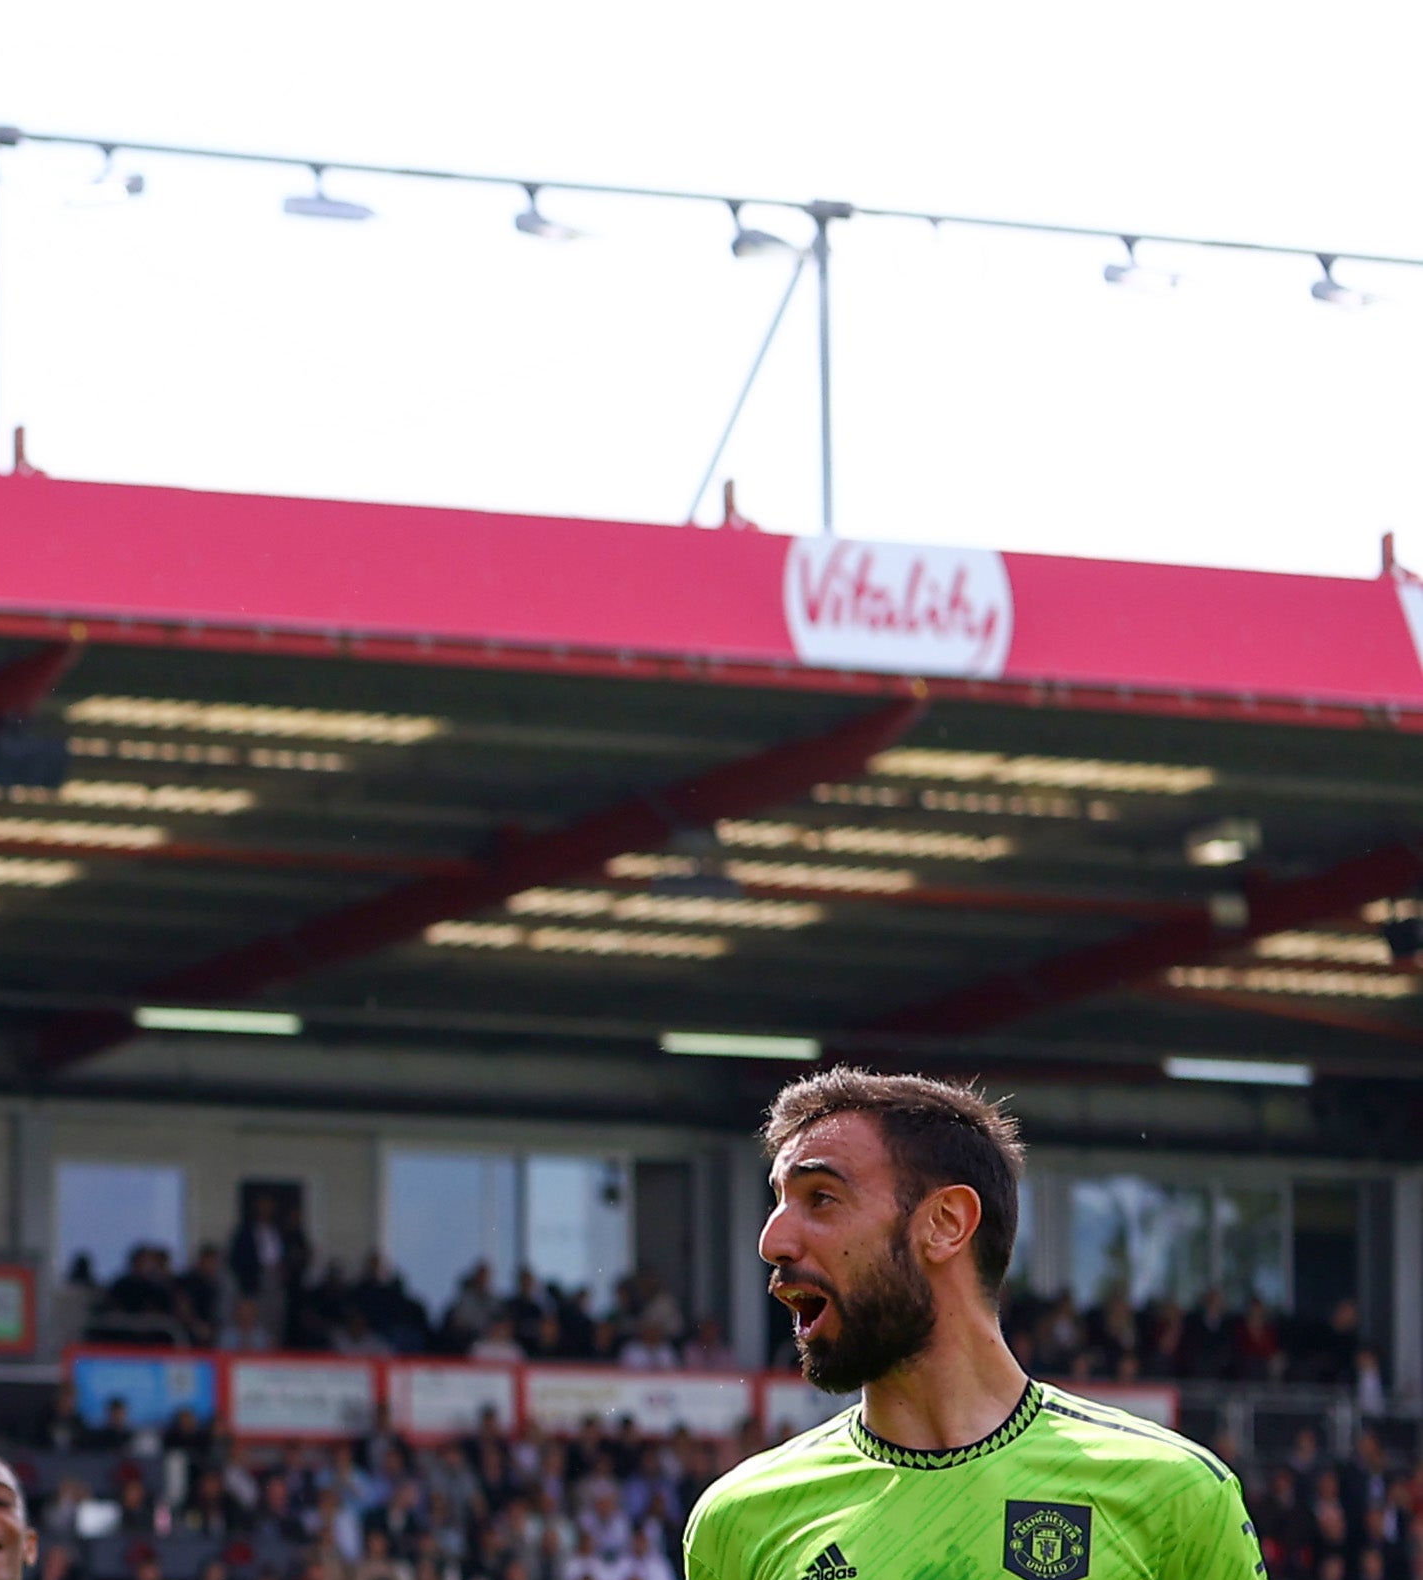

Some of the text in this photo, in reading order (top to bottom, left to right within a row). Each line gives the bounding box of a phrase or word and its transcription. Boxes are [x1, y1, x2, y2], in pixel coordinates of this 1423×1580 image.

[798, 540, 998, 670] Vitality
[1017, 1514, 1078, 1541] MANCHESTER
[1025, 1559, 1068, 1574] UNITED
